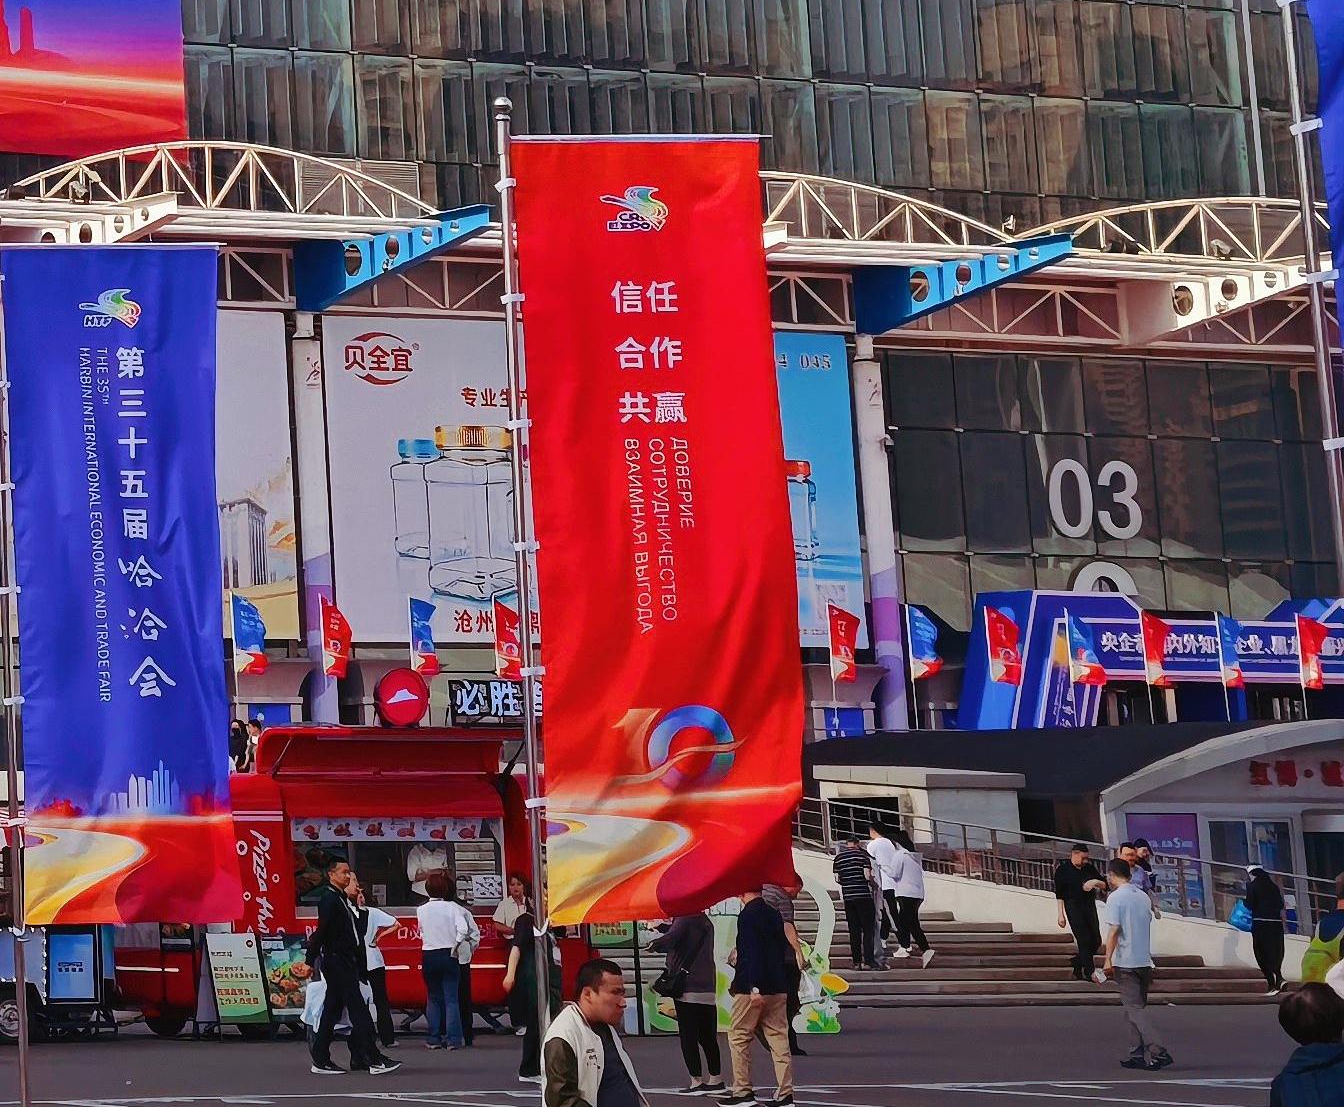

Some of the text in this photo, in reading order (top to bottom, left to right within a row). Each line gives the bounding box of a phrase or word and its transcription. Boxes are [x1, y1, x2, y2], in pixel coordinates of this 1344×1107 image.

[611, 280, 679, 315] 信任
[97, 347, 109, 373] THE
[344, 344, 413, 372] 贝全宜
[614, 336, 683, 370] 合作
[618, 391, 688, 424] 共赢
[670, 436, 695, 530] ДОВЕРИЕ
[1048, 458, 1144, 540] 03
[79, 347, 112, 702] HARBIN INTERNATIONAL ECONOMIC AND TRADE FAIR
[624, 438, 653, 635] ВЗАИМНАЯ ВЫГОДА
[647, 437, 678, 622] СОТРУДНИЧЕСТВО
[249, 829, 274, 934] Pizza Hu
